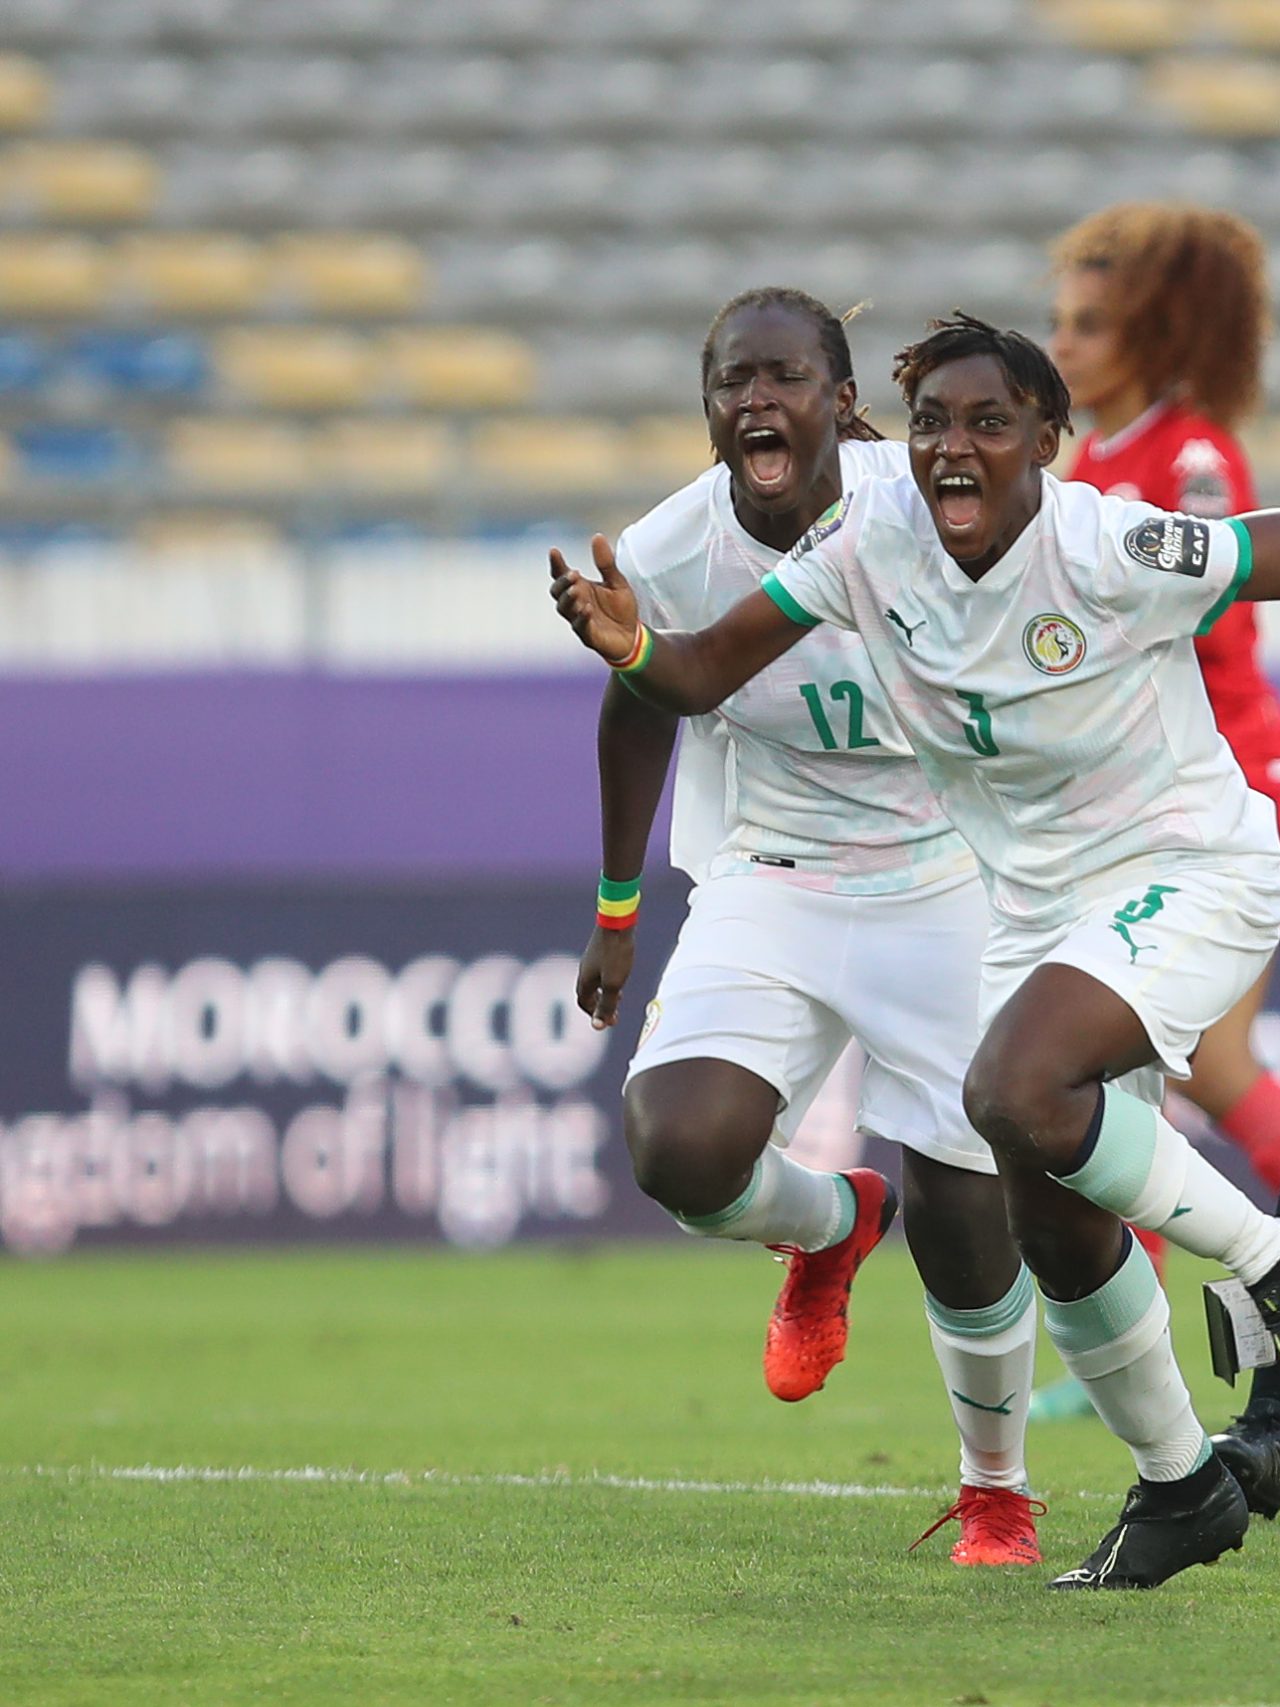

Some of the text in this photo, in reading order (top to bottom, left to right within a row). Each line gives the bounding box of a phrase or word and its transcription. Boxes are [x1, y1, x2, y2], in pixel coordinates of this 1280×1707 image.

[1192, 526, 1205, 566] CAF
[798, 680, 881, 751] 12
[954, 689, 1001, 757] 3
[70, 955, 610, 1095] MOROCCO
